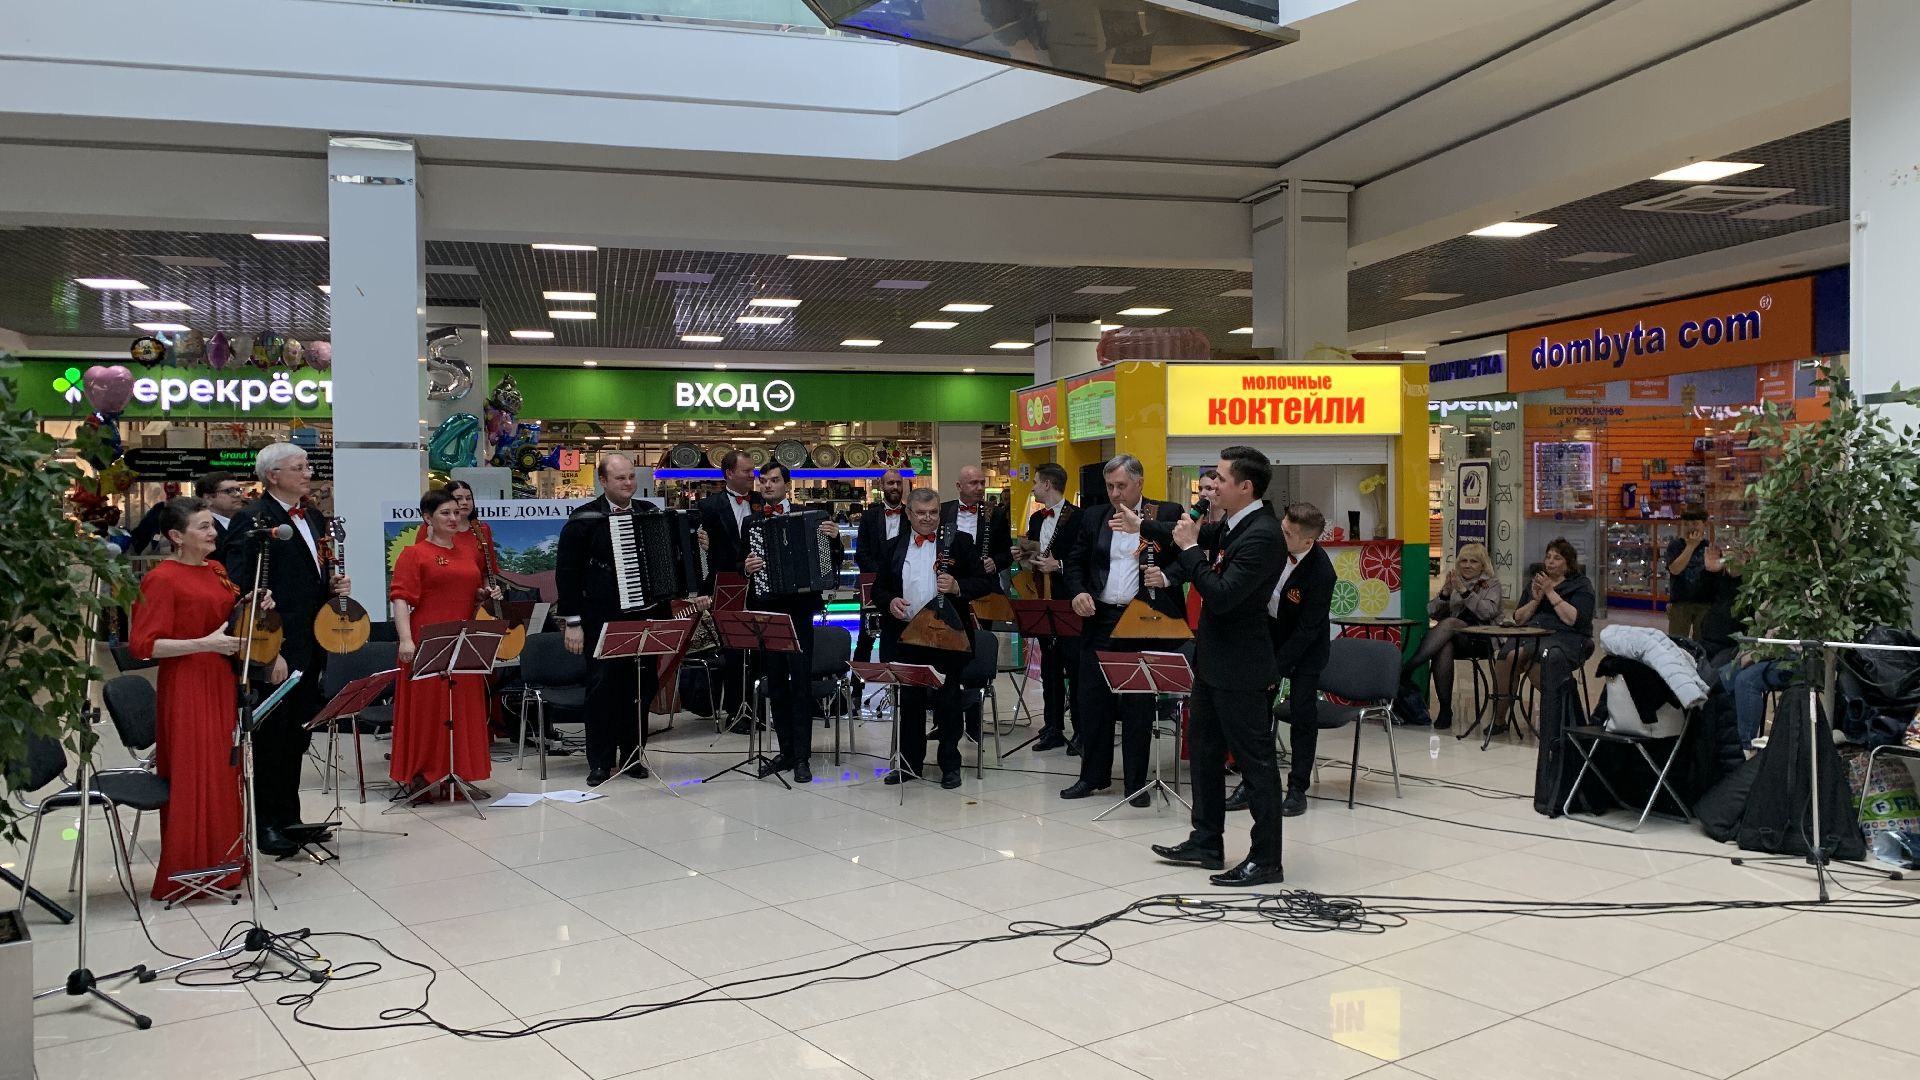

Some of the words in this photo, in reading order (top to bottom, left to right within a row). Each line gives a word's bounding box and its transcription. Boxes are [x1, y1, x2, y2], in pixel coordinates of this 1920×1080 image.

[1531, 320, 1665, 371] dombyta
[1678, 309, 1762, 349] com
[1429, 354, 1503, 383] ИМЧИСТКА
[132, 372, 333, 410] ерекрёст
[676, 382, 760, 412] ВХОД
[1208, 392, 1365, 425] коктейли
[1493, 421, 1516, 431] Clean
[219, 451, 248, 460] Grand
[392, 506, 511, 519] КОМНЫЕ
[514, 505, 561, 519] ДОМА
